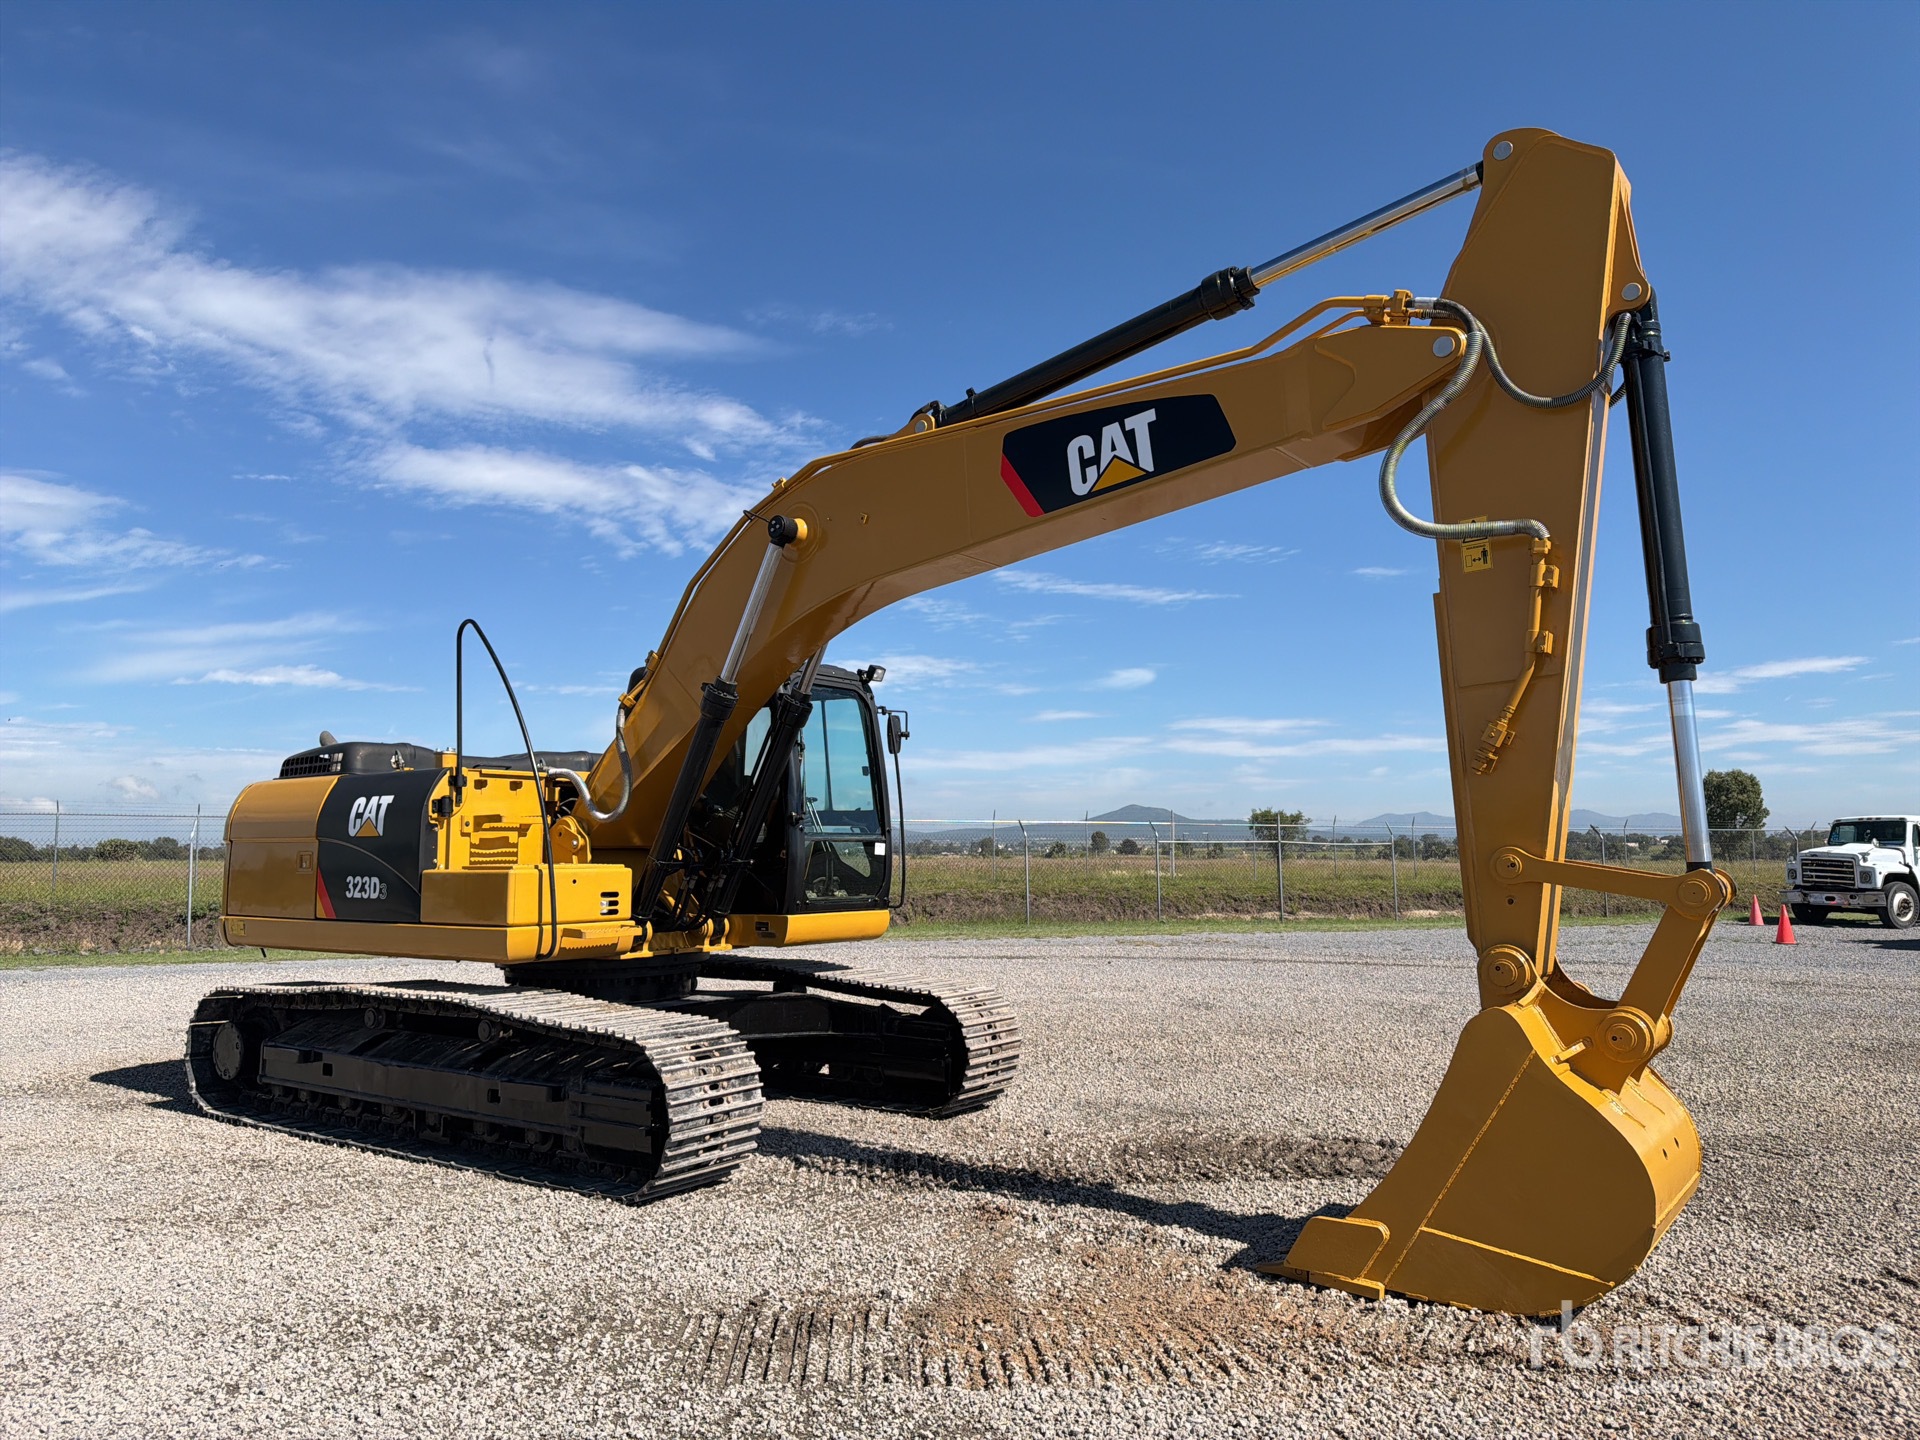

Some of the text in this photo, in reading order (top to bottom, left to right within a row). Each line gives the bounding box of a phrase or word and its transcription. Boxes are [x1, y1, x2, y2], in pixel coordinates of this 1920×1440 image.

[1067, 408, 1156, 496] CAT
[348, 795, 395, 837] CAT
[346, 876, 387, 899] 323D3
